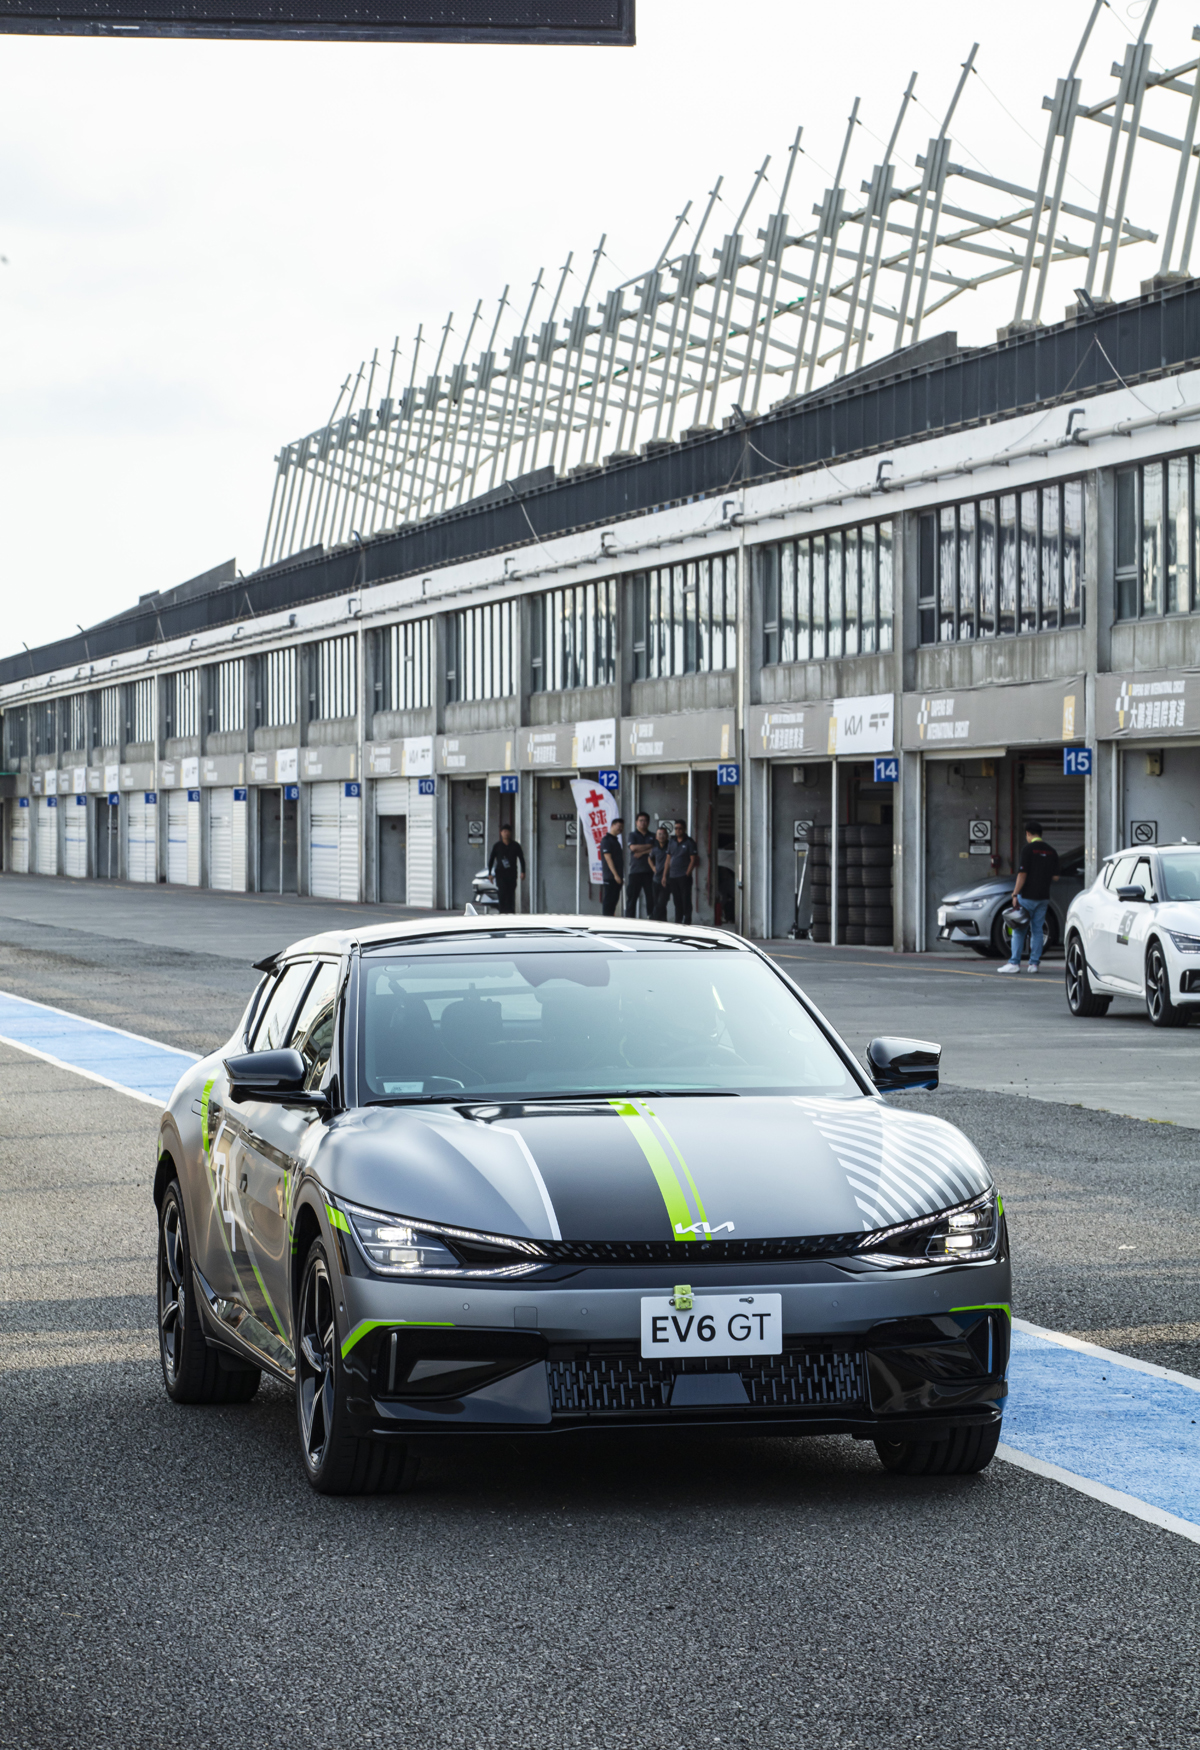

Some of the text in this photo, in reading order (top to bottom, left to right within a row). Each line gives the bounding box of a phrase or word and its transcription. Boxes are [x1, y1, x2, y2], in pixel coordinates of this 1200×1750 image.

[1067, 752, 1090, 771] 15
[719, 767, 738, 783] 13
[877, 761, 898, 779] 14
[503, 778, 517, 791] 11
[600, 773, 618, 787] 12
[290, 787, 299, 799] 8
[350, 784, 359, 796] 9
[420, 781, 434, 793] 10
[112, 795, 118, 804] 4
[148, 794, 155, 803] 5
[191, 791, 199, 801] 6
[238, 790, 246, 800] 7
[674, 1221, 736, 1235] KIA
[651, 1312, 772, 1344] EV6 GT
